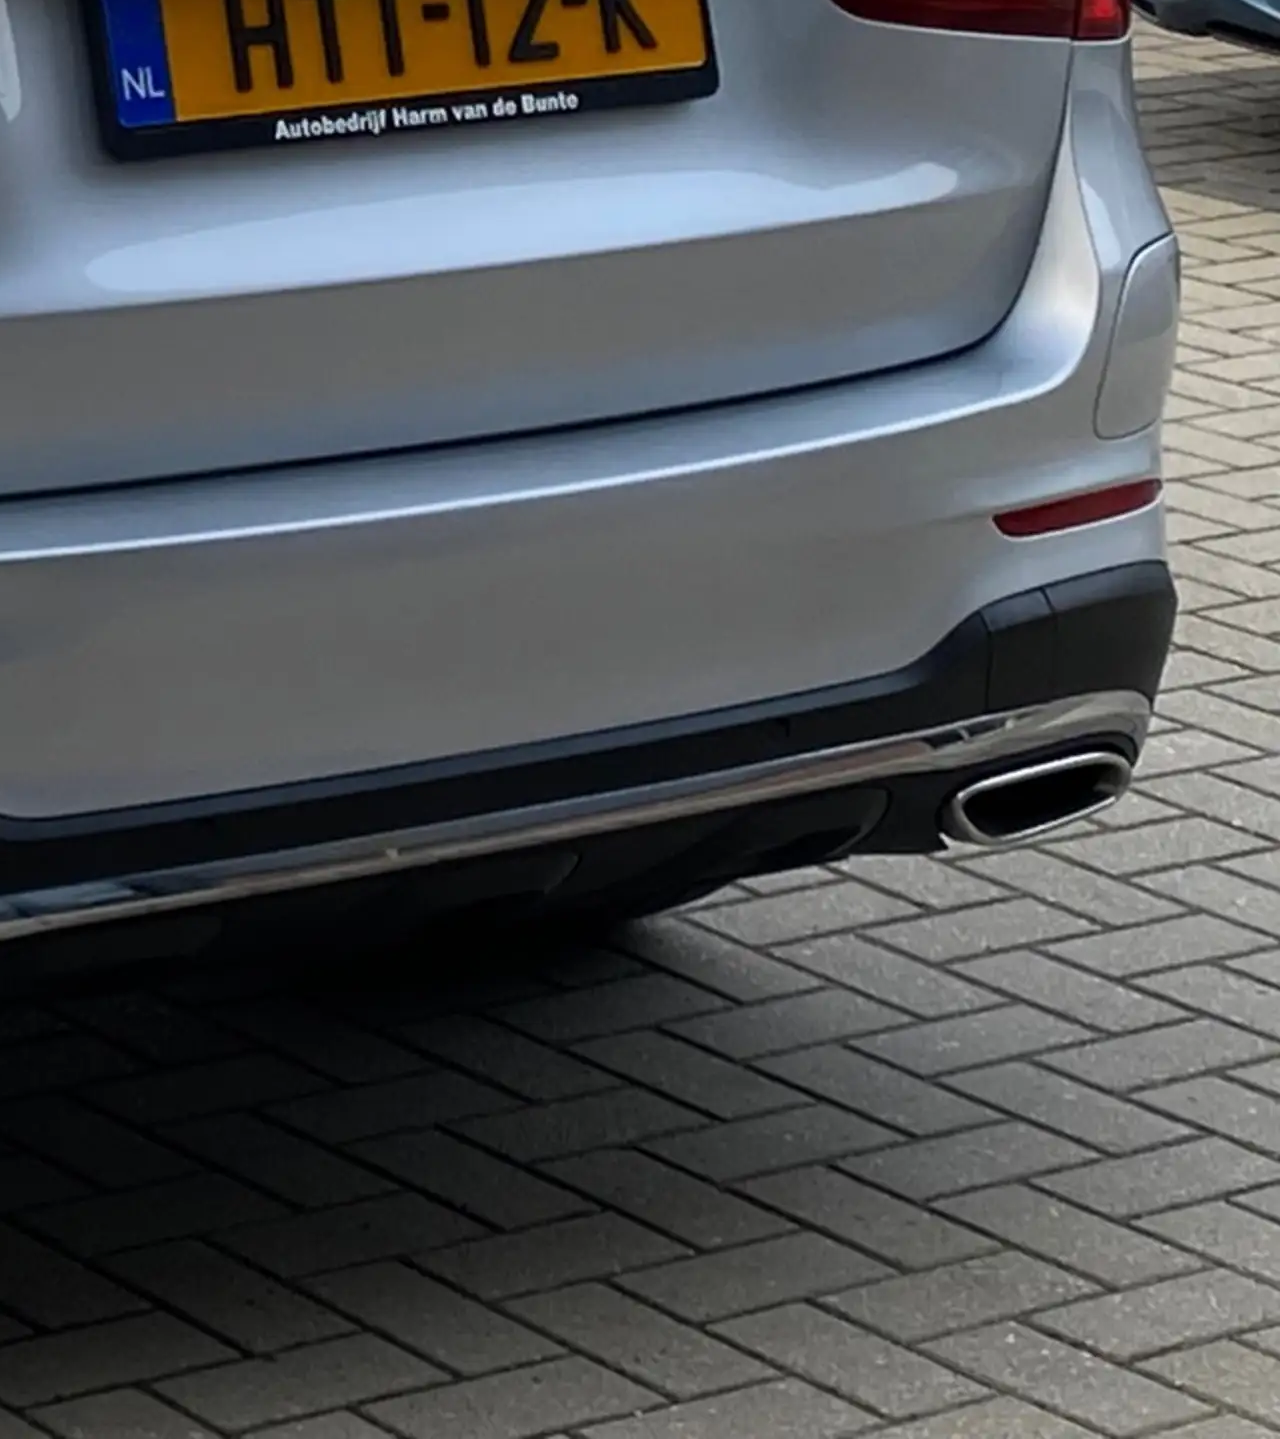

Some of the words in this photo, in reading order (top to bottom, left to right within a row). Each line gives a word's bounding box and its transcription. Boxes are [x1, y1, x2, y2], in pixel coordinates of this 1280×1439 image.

[121, 65, 165, 101] NL
[274, 110, 388, 140] Autobedrijf
[392, 106, 447, 128] Harm
[451, 102, 488, 121] van
